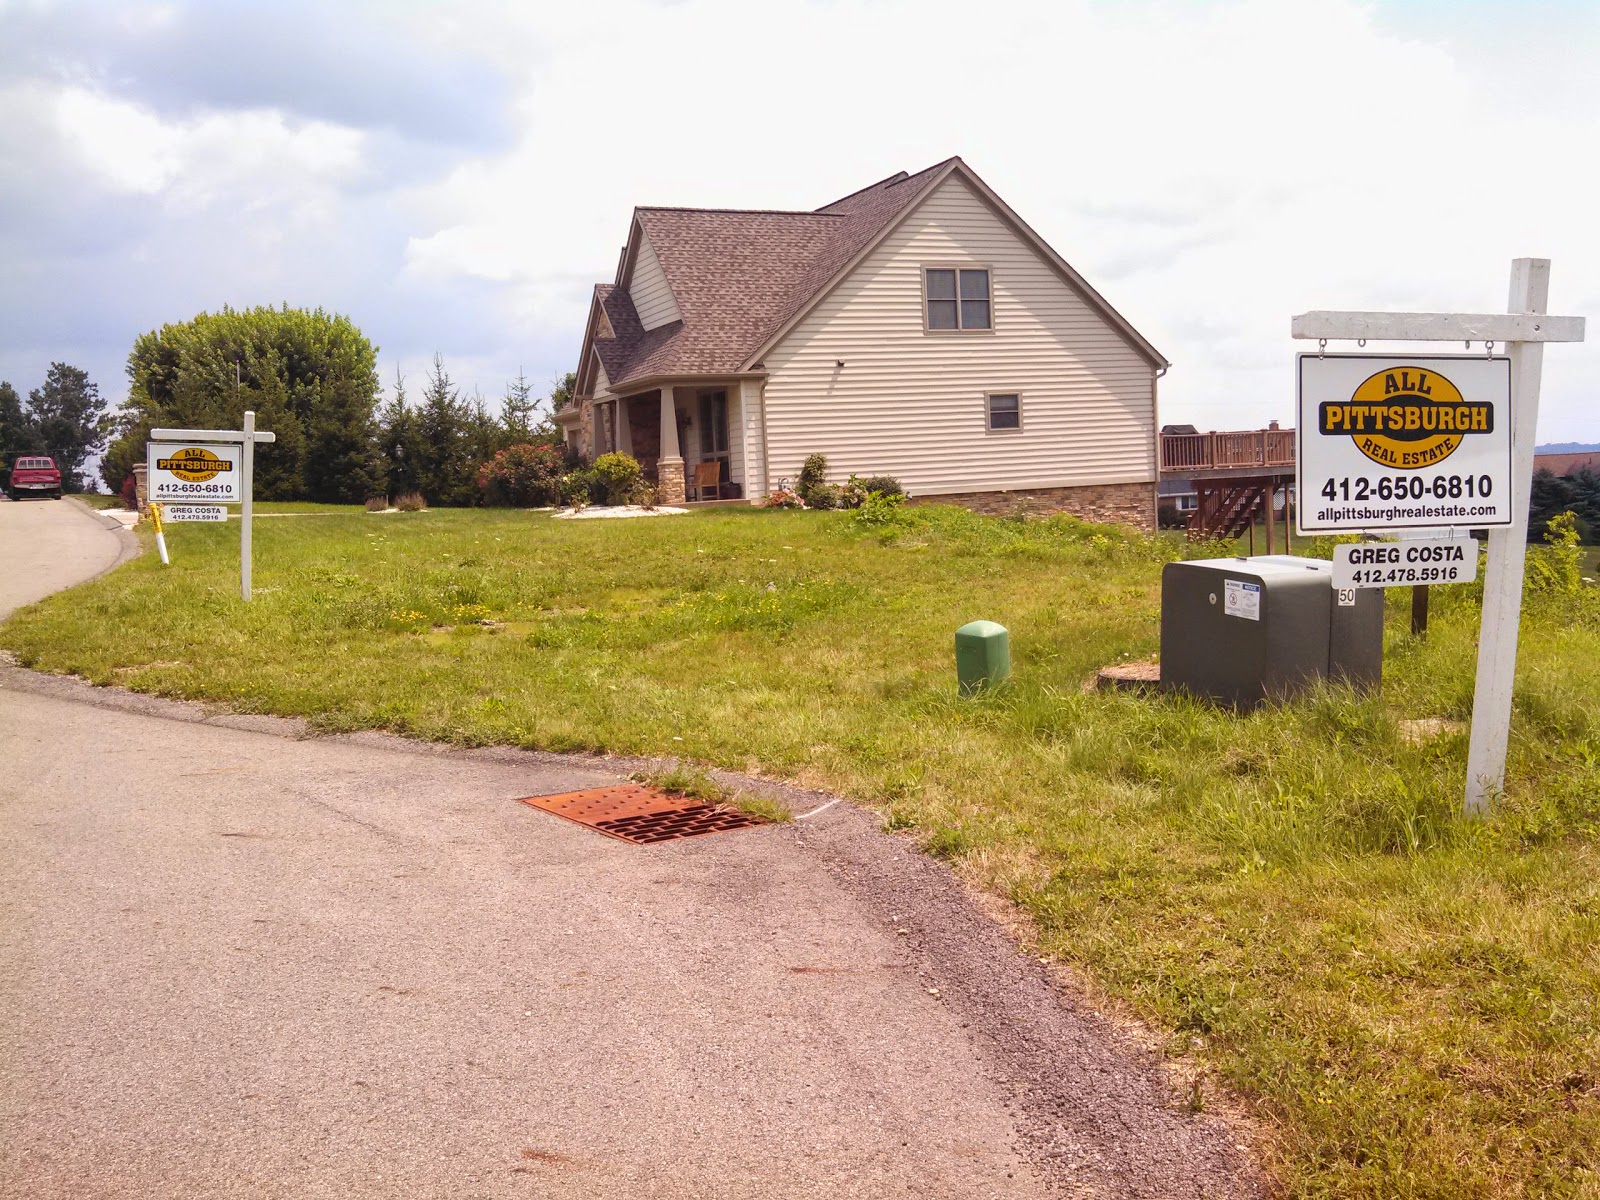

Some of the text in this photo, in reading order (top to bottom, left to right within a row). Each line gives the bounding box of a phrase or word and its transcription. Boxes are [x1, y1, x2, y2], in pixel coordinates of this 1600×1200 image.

[1384, 372, 1432, 395] ALL
[1325, 405, 1488, 430] PITTSBURGH
[185, 450, 205, 458] ALL
[1362, 437, 1454, 465] REAL ESTATE
[159, 460, 230, 470] PITTSBURGH
[175, 471, 215, 481] REAL ESTATE
[158, 484, 232, 493] 412-650-6810
[1322, 475, 1492, 501] 412-650-6810
[1317, 505, 1496, 522] allpittsburghrealestate.com
[1348, 546, 1464, 565] GREG COSTA
[1352, 566, 1458, 584] 412.478.5916
[1339, 588, 1355, 602] 50
